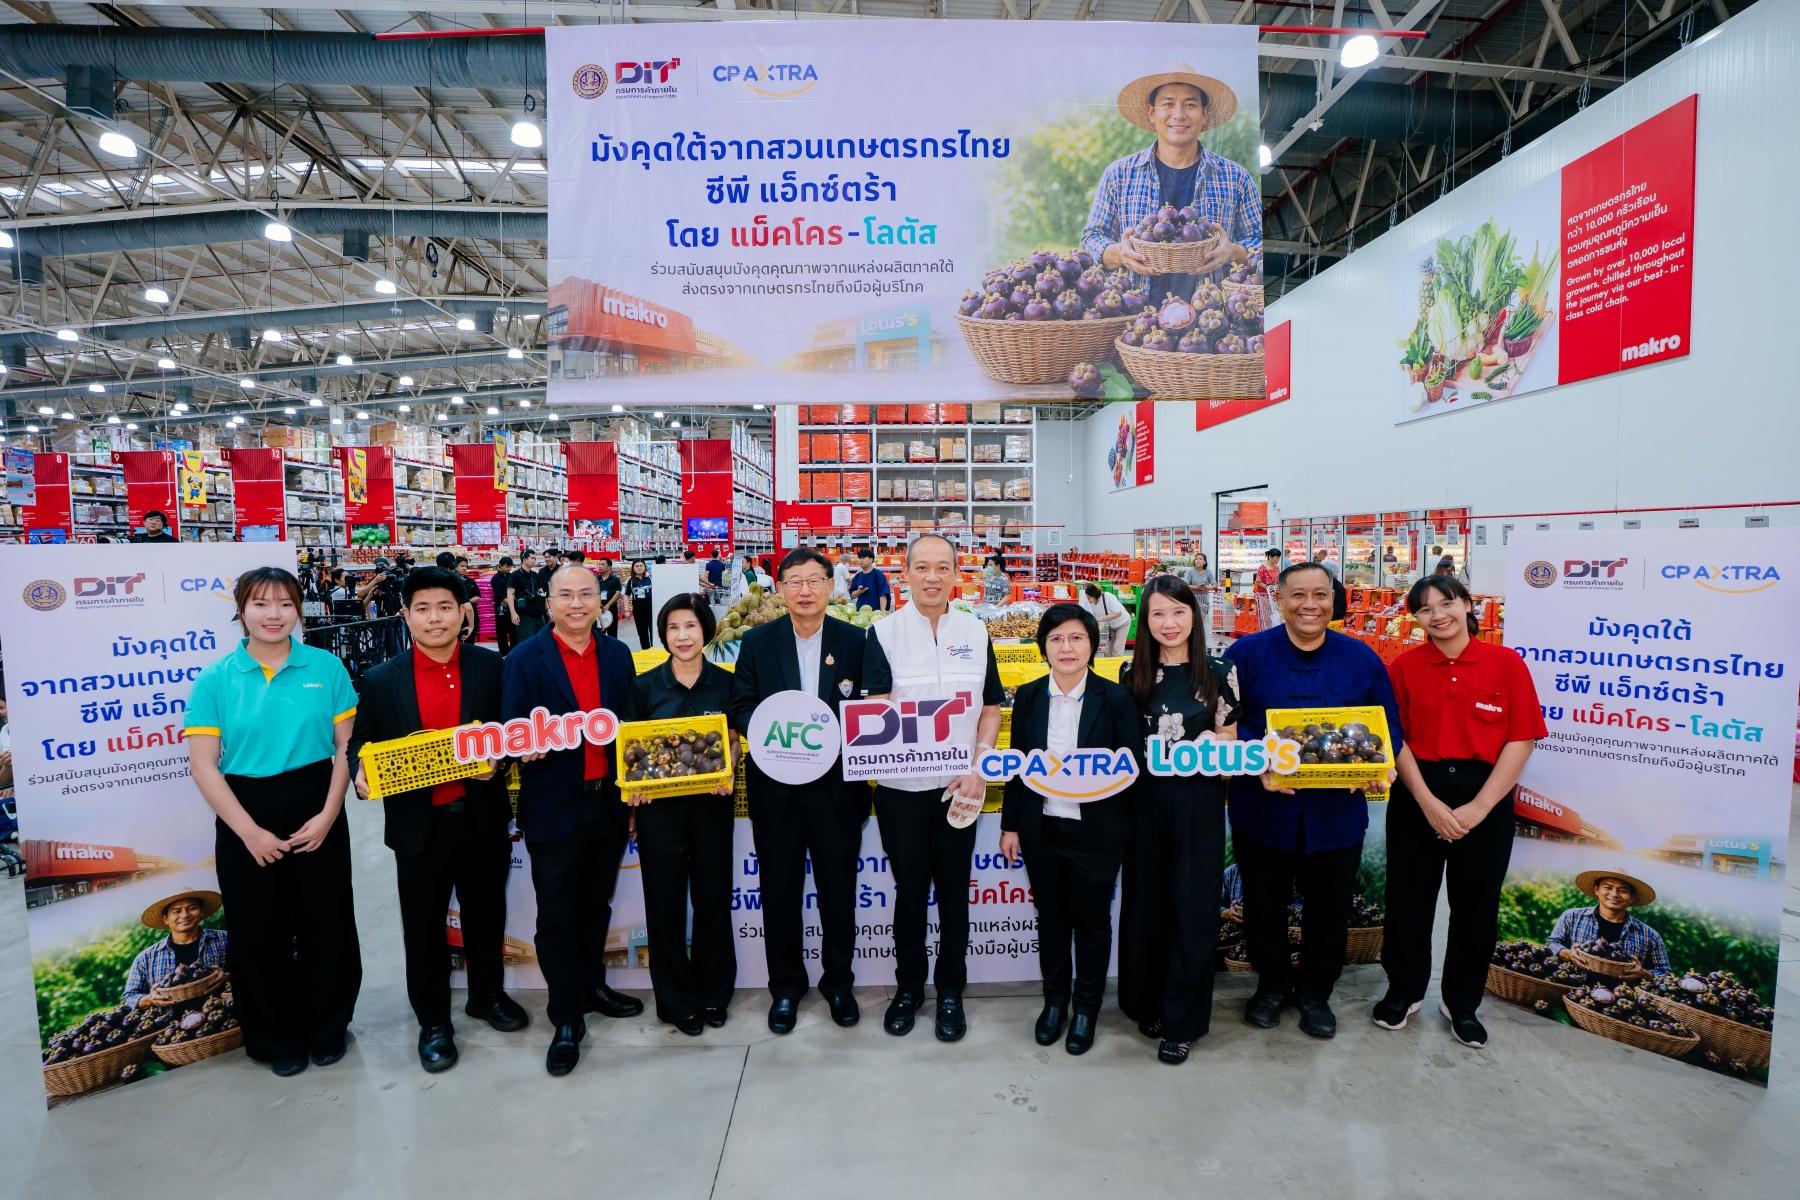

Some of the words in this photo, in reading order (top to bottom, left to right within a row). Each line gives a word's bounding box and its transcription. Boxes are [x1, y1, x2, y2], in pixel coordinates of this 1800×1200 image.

[616, 86, 677, 94] กรมการค้าภายใน
[591, 129, 1011, 170] มังคุดใต้จากสวนเกษตรกรไทย
[706, 176, 750, 204] ซีพี
[760, 171, 896, 203] แอ็กซ์ตร้า
[1567, 182, 1647, 226] สดจากเกษตรกรไทย
[1567, 226, 1583, 239] กว่า
[1585, 212, 1614, 231] 10,000
[1616, 193, 1657, 217] ครัวเรือน
[666, 218, 719, 248] โดย
[1567, 203, 1668, 254] ควบคุมอุณหภูมิความเย็น
[1566, 272, 1591, 286] Grown
[1593, 267, 1604, 277] by
[1606, 259, 1626, 271] over
[1629, 244, 1659, 262] 10,000
[1661, 232, 1685, 250] local
[1567, 237, 1628, 268] ตลอดการขนส่ง
[650, 259, 954, 280] ร่วมสนับสนุนมังคุดคุณภาพจากแหล่งผลิตภาคใต้
[1566, 281, 1599, 300] growers,
[1602, 267, 1630, 285] chilled
[1633, 247, 1685, 274] throughout
[682, 278, 924, 298] ส่งตรงจากเกษตรกรไทยถึงมือผู้บริโภค
[1566, 299, 1578, 310] the
[1579, 289, 1609, 307] journey
[1611, 283, 1624, 293] via
[1626, 278, 1641, 289] our
[603, 297, 668, 328] makro
[1565, 310, 1584, 321] class
[1586, 301, 1603, 315] cold
[1605, 295, 1629, 308] chain.
[860, 312, 918, 332] Lotus's
[1622, 334, 1681, 362] makro
[56, 454, 62, 463] 8
[114, 453, 120, 461] 9
[162, 452, 172, 461] 10
[222, 450, 230, 460] 11
[272, 449, 281, 458] 12
[333, 449, 341, 458] 13
[383, 447, 392, 457] 14
[1588, 616, 1692, 645] มังคุดใต้
[112, 629, 216, 660] มังคุดใต้
[1555, 673, 1591, 694] ซีพี
[1599, 675, 1724, 707] แอ็กซ์ตร้า
[80, 703, 122, 724] ซีพี
[1475, 702, 1502, 713] makro
[457, 709, 617, 762] makro
[763, 721, 824, 750] AFC
[42, 738, 96, 761] โดย
[848, 747, 968, 766] กรมการค้าภายใน
[1151, 737, 1298, 772] Lotus's
[848, 768, 899, 777] Department
[910, 764, 943, 773] Internal
[945, 763, 969, 771] Trade
[1520, 791, 1563, 817] makro
[56, 844, 114, 860] makro
[1709, 837, 1759, 851] Lotus's
